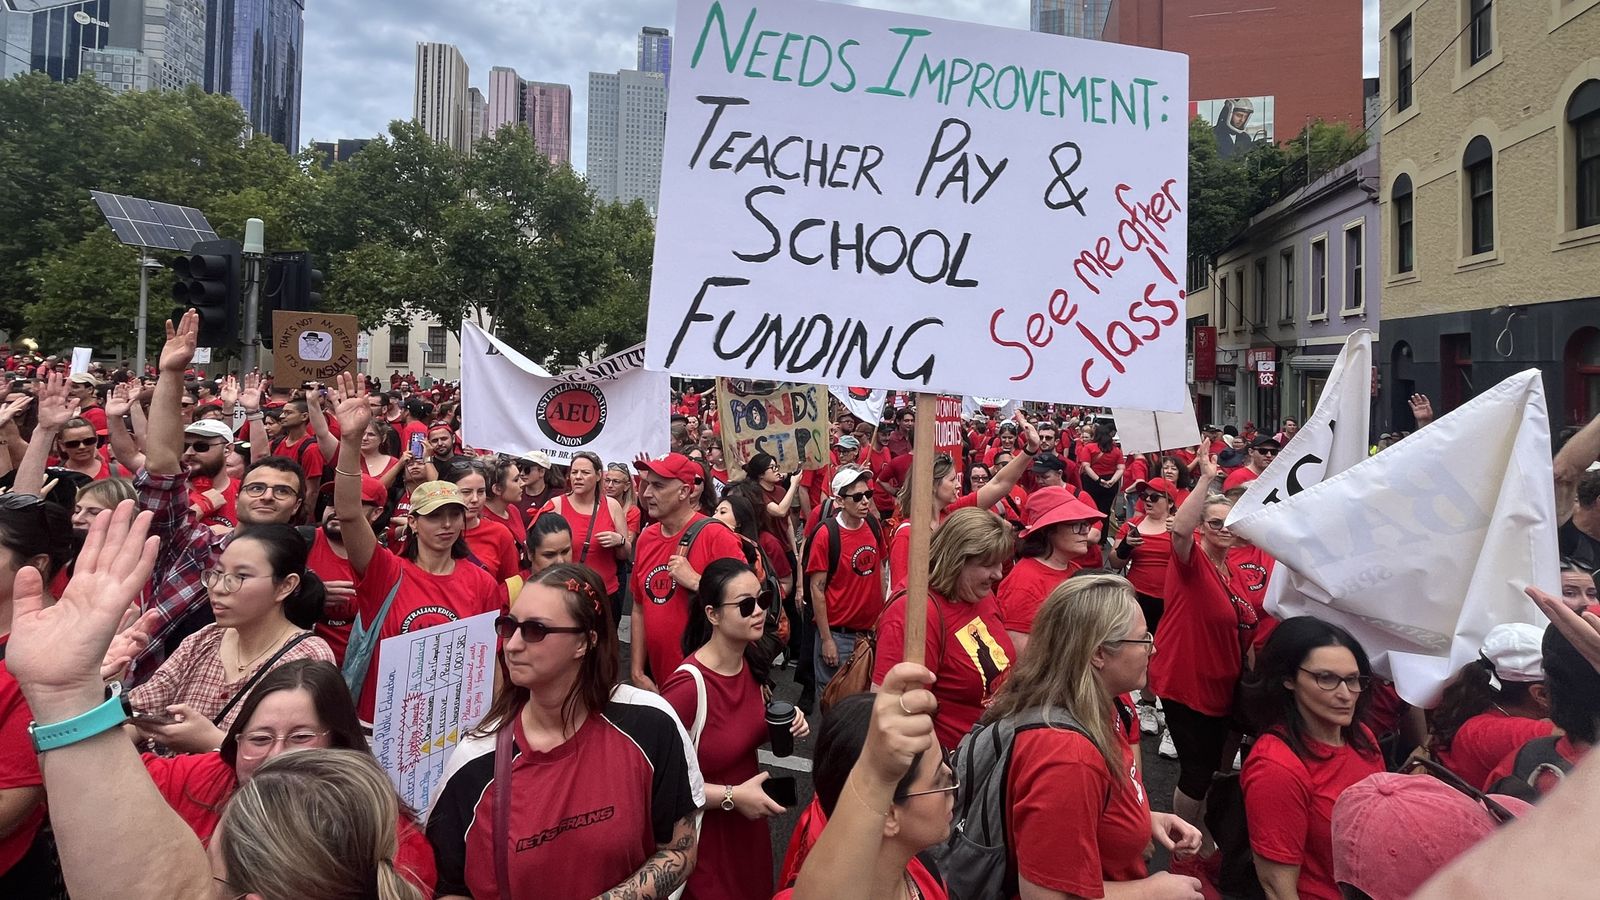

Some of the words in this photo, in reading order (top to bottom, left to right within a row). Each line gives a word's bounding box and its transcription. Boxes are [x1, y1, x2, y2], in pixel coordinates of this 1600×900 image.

[690, 1, 860, 93] NEEDS
[865, 27, 1169, 130] IMPROVEMENT:
[689, 95, 883, 196] TEACHER
[914, 117, 1008, 205] PAY
[1043, 140, 1089, 217] &
[732, 185, 979, 288] SCHOOL
[990, 288, 1078, 381] See
[1115, 178, 1182, 254] after
[280, 325, 298, 348] THAT'S
[296, 318, 313, 329] NOT
[321, 320, 334, 329] AN
[664, 277, 944, 385] FUNDING
[1080, 247, 1187, 398] class!
[284, 354, 299, 368] IT'S
[300, 366, 313, 375] AN
[537, 382, 579, 420] AUSTRALIAN
[580, 383, 606, 424] EDUCATION
[548, 402, 596, 423] AEU
[729, 386, 818, 433] PONDS
[556, 435, 582, 446] UNION
[935, 421, 961, 447] TUDENTS
[401, 607, 437, 634] AUSTRALIAN
[438, 607, 458, 622] EDUCA
[378, 668, 396, 712] Education
[375, 712, 392, 742] Public
